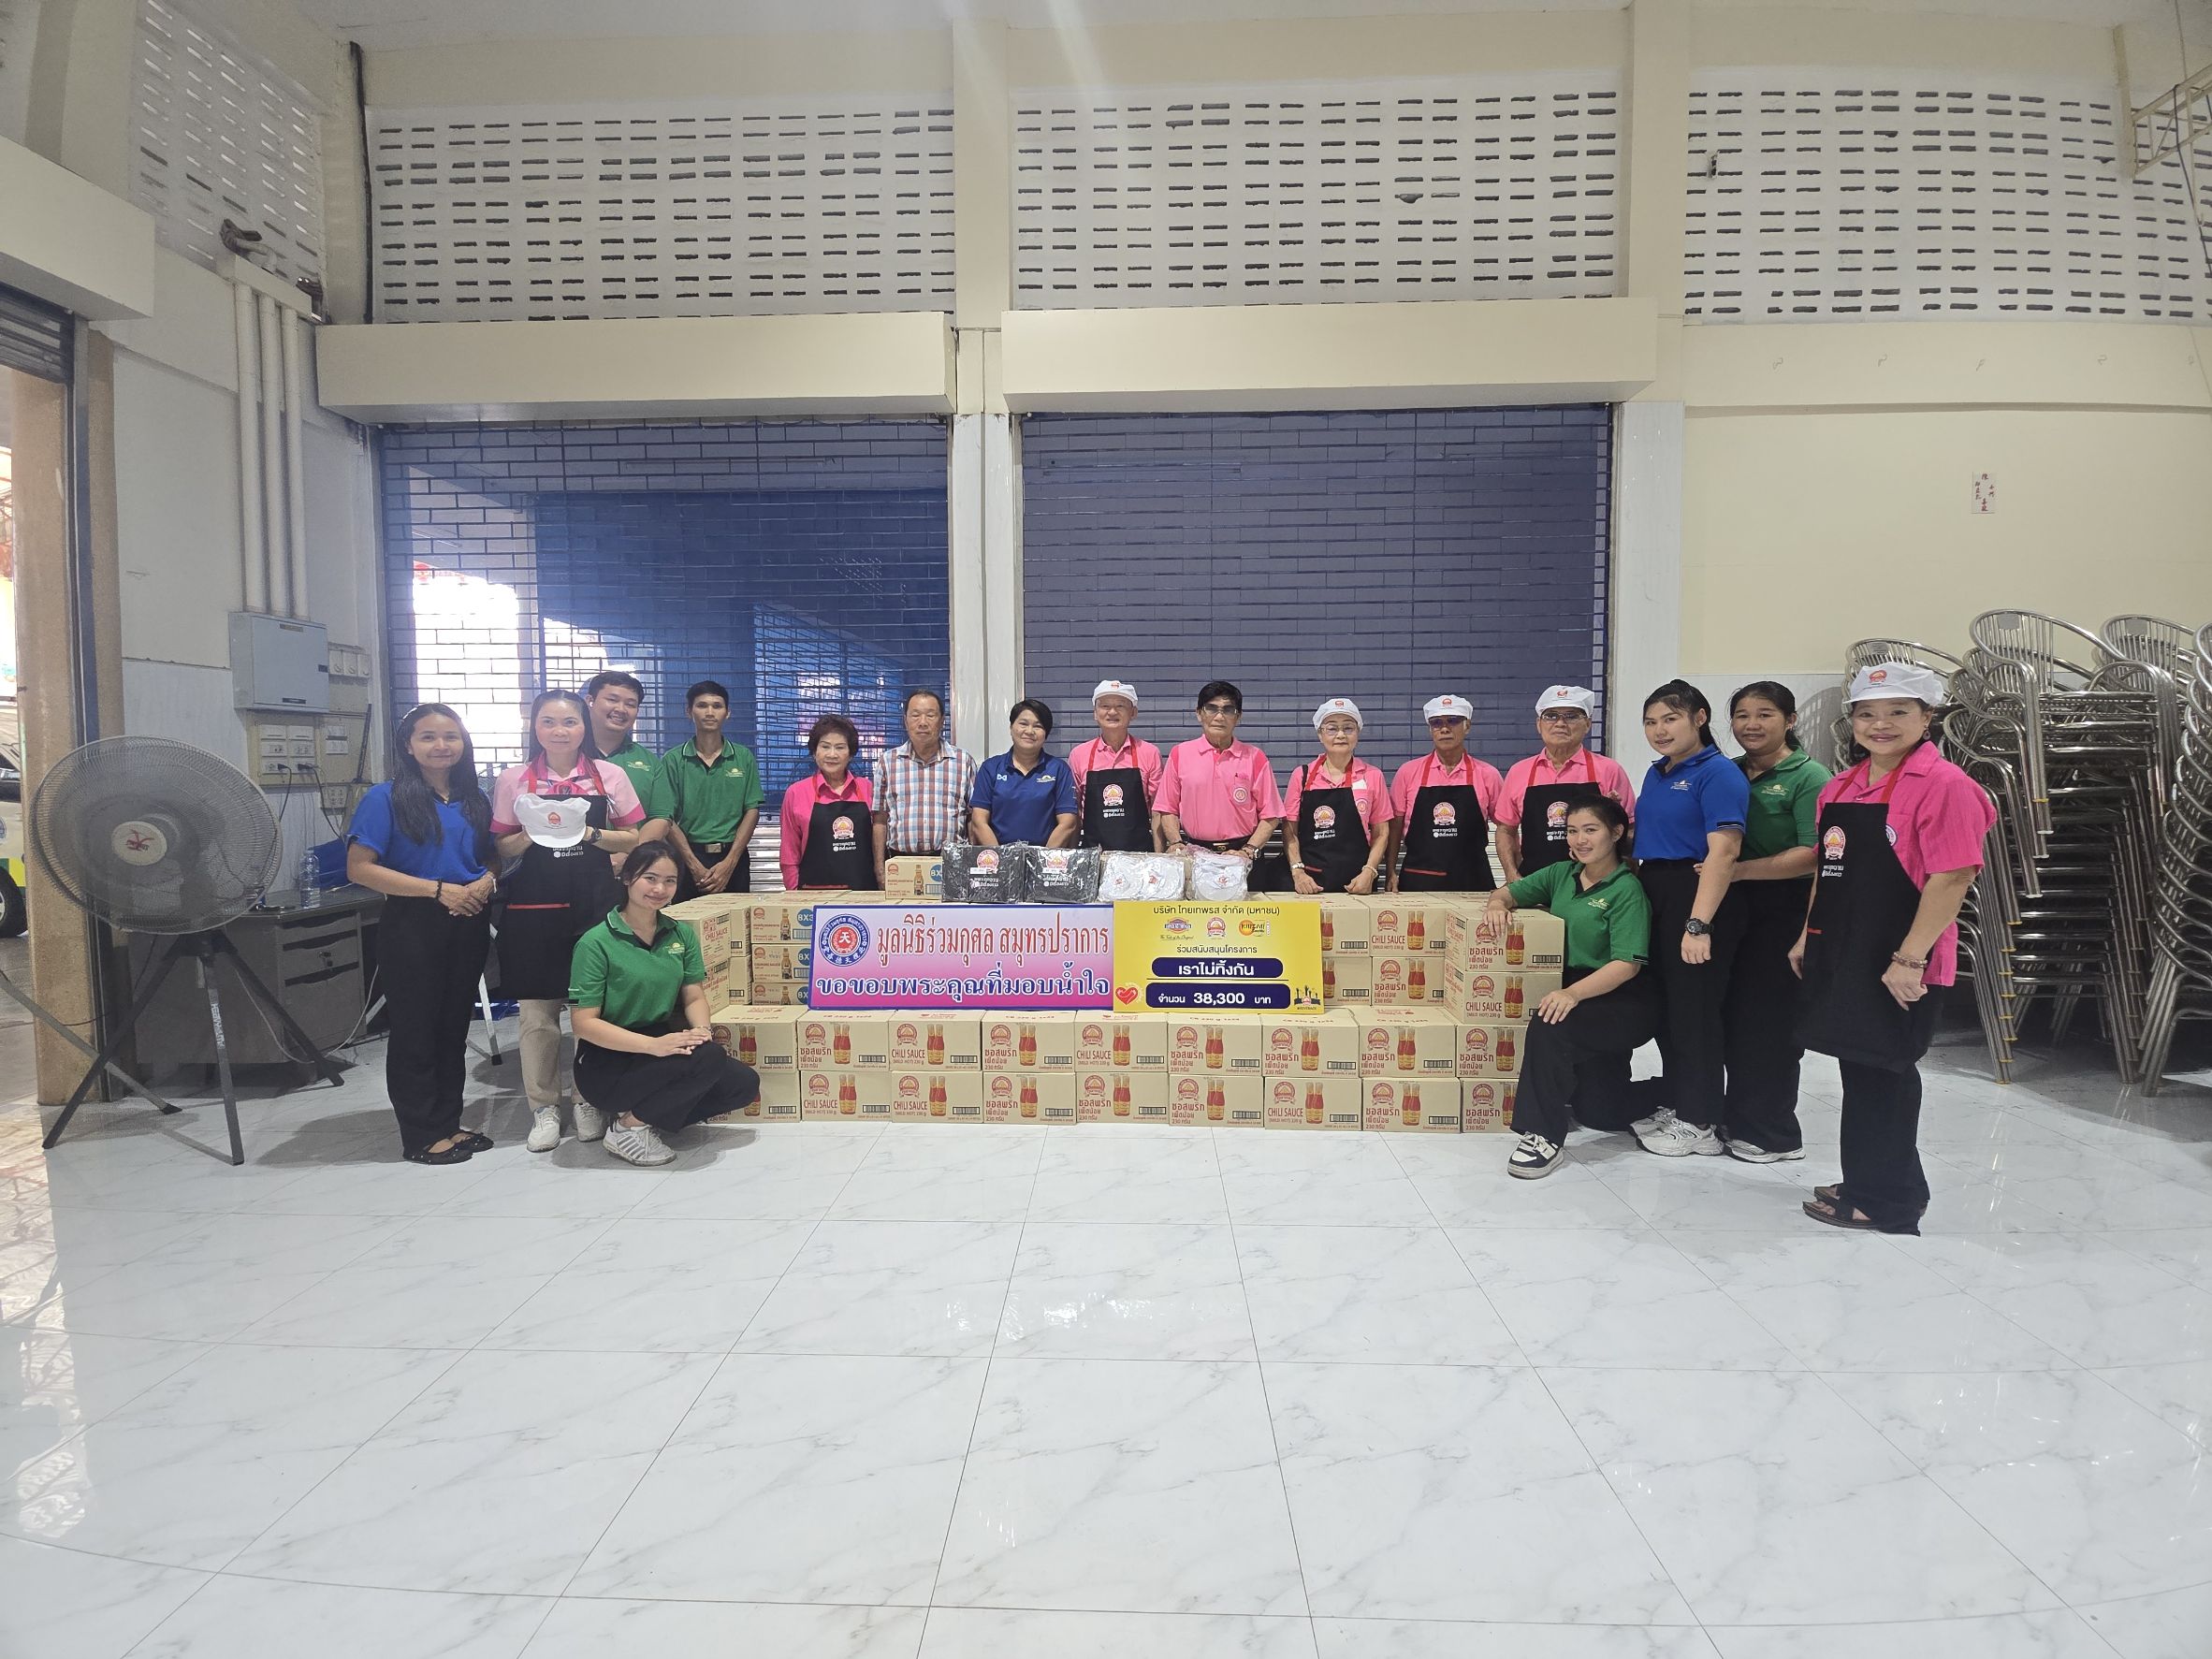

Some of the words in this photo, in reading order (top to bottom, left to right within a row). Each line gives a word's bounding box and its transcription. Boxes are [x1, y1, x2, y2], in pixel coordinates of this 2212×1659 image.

[1153, 906, 1176, 914] บริษัท
[1178, 905, 1220, 914] ไทยเทพรส
[1222, 906, 1244, 914] จำกัด
[1246, 906, 1280, 915] (มหาชน)
[838, 932, 851, 943] 天
[878, 913, 994, 967] มูลนิธิร่วมกุศล
[999, 911, 1109, 967] สมุทรปราการ
[1177, 945, 1258, 954] ร่วมสนับสนุนโครงการ
[1469, 947, 1503, 955] ซอสพริก
[1178, 960, 1255, 976] เราไม่ทิ้งกัน
[817, 962, 1109, 1001] ขอขอบพระคุณที่มอบน้ำใจ
[1158, 994, 1186, 1004] จำนวน
[1194, 992, 1245, 1005] 38,300
[1465, 1002, 1481, 1011] CHILI
[1482, 1002, 1503, 1011] SAUCE
[800, 1046, 831, 1055] ซอสพริก
[891, 1049, 906, 1058] CHILI
[908, 1049, 925, 1058] SAUCE
[984, 1048, 1017, 1057] ซอสพริก
[1076, 1050, 1091, 1059] CHILI
[1092, 1050, 1112, 1059] SAUCE
[1171, 1050, 1203, 1059] ซอสพริก
[1265, 1053, 1299, 1061] ซอสพริก
[1361, 1052, 1395, 1061] ซอสพริก
[1460, 1054, 1493, 1062] ซอสพริก
[804, 1099, 818, 1108] CHILI
[820, 1099, 838, 1108] SAUCE
[894, 1100, 908, 1110] CHILI
[910, 1100, 927, 1110] SAUCE
[986, 1100, 1018, 1109] ซอสพริก
[1079, 1099, 1112, 1107] ซอสพริก
[1171, 1102, 1205, 1112] ซอสพริก
[1267, 1108, 1284, 1117] CHILI
[1284, 1108, 1303, 1117] SAUCE
[1366, 1107, 1400, 1115] ซอสพริก
[1465, 1108, 1500, 1117] ซอสพริก
